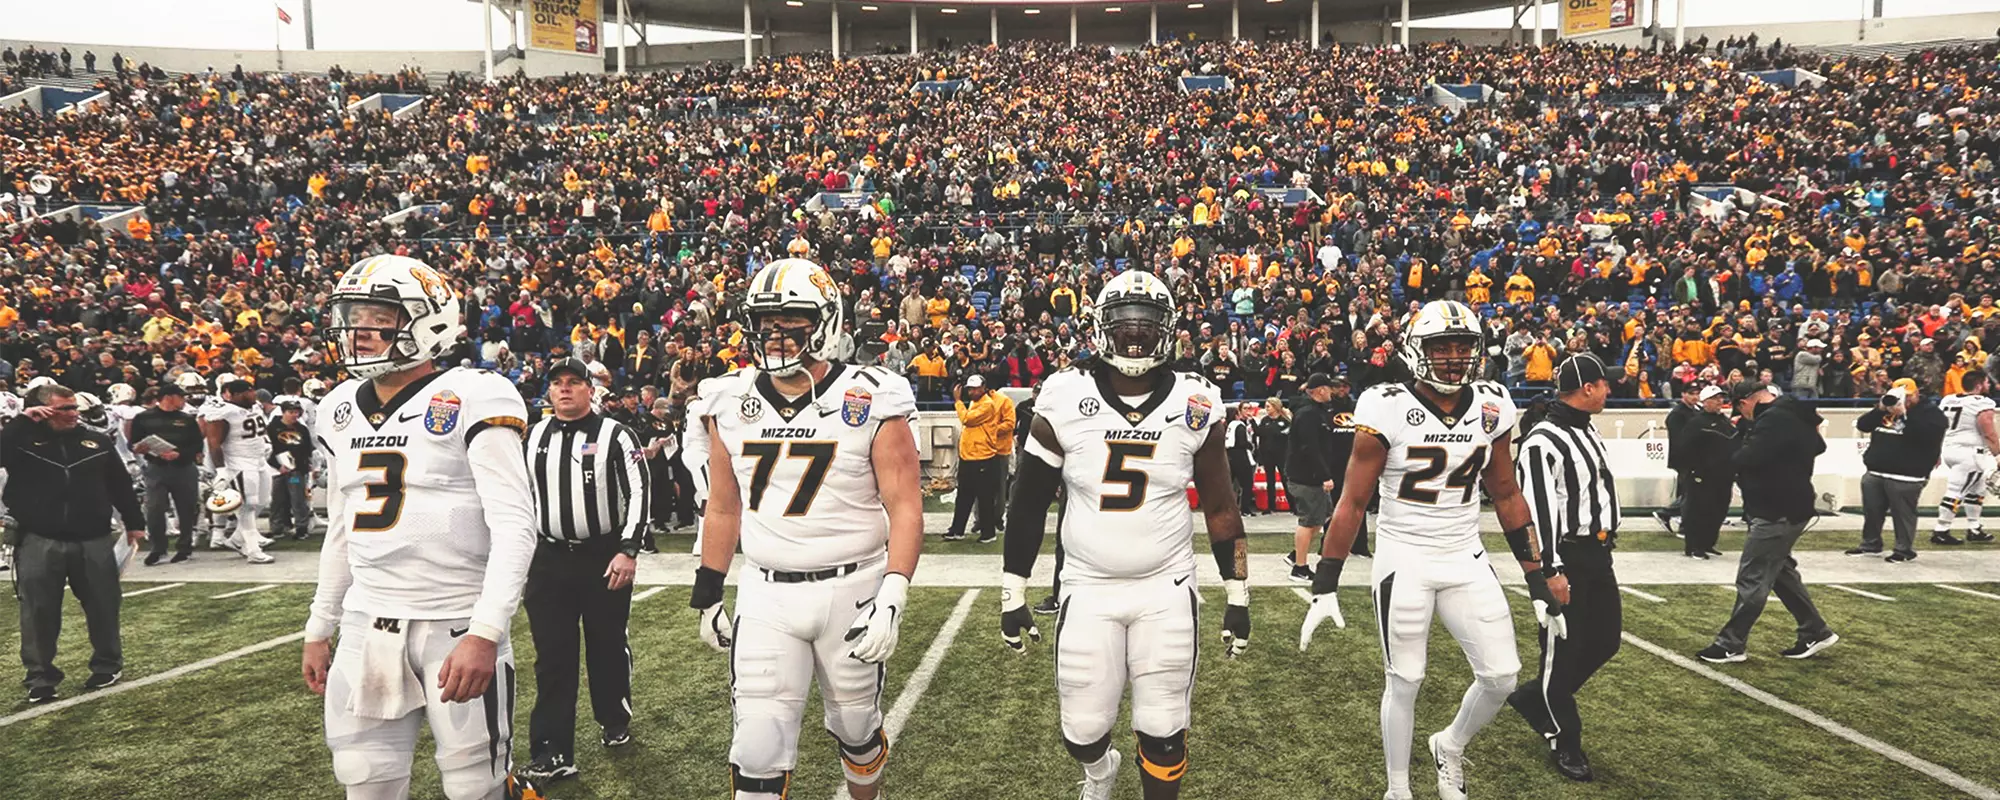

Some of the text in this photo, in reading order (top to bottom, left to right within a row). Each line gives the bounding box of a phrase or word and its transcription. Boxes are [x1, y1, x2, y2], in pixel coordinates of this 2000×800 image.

[533, 1, 579, 16] TRUCK
[1568, 0, 1597, 9] OIL.
[534, 13, 562, 27] OIL.
[742, 398, 761, 417] SEC
[1079, 398, 1100, 416] SEC
[1406, 408, 1425, 426] SEC
[242, 415, 268, 439] 99
[761, 428, 817, 438] MIZZOU
[1104, 430, 1162, 440] MIZZOU
[351, 436, 408, 449] MIZZOU
[1424, 434, 1473, 443] MIZZOU
[1646, 443, 1663, 452] BIG
[584, 470, 593, 484] F
[741, 440, 838, 517] 77
[1100, 440, 1158, 512] 5
[1397, 445, 1488, 505] 24
[352, 450, 408, 532] 3
[373, 617, 401, 634] M
